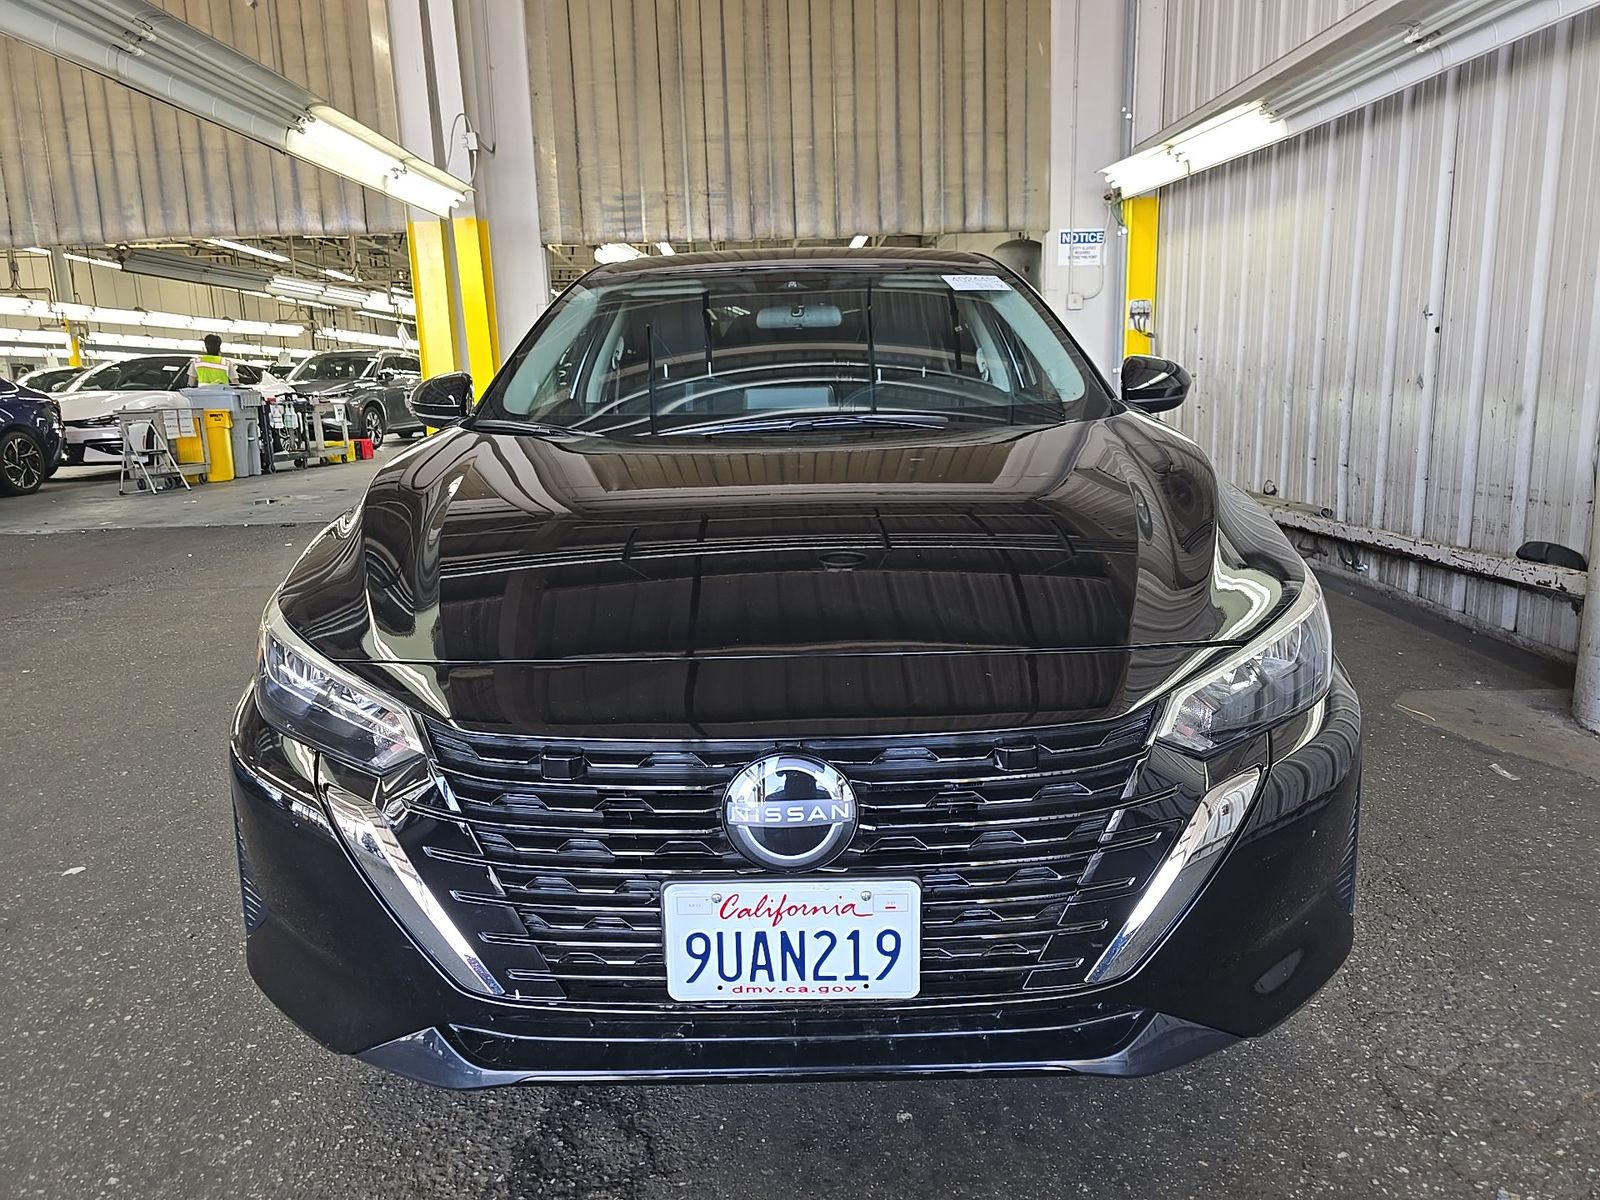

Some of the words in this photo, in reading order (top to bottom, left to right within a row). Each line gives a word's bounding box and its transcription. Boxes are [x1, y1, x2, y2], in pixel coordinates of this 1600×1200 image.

[1062, 232, 1104, 243] NOTICE
[730, 802, 849, 823] NISSAN
[719, 893, 874, 927] California
[685, 928, 901, 983] 9UAN219
[731, 985, 858, 995] dmv.ca.gov
